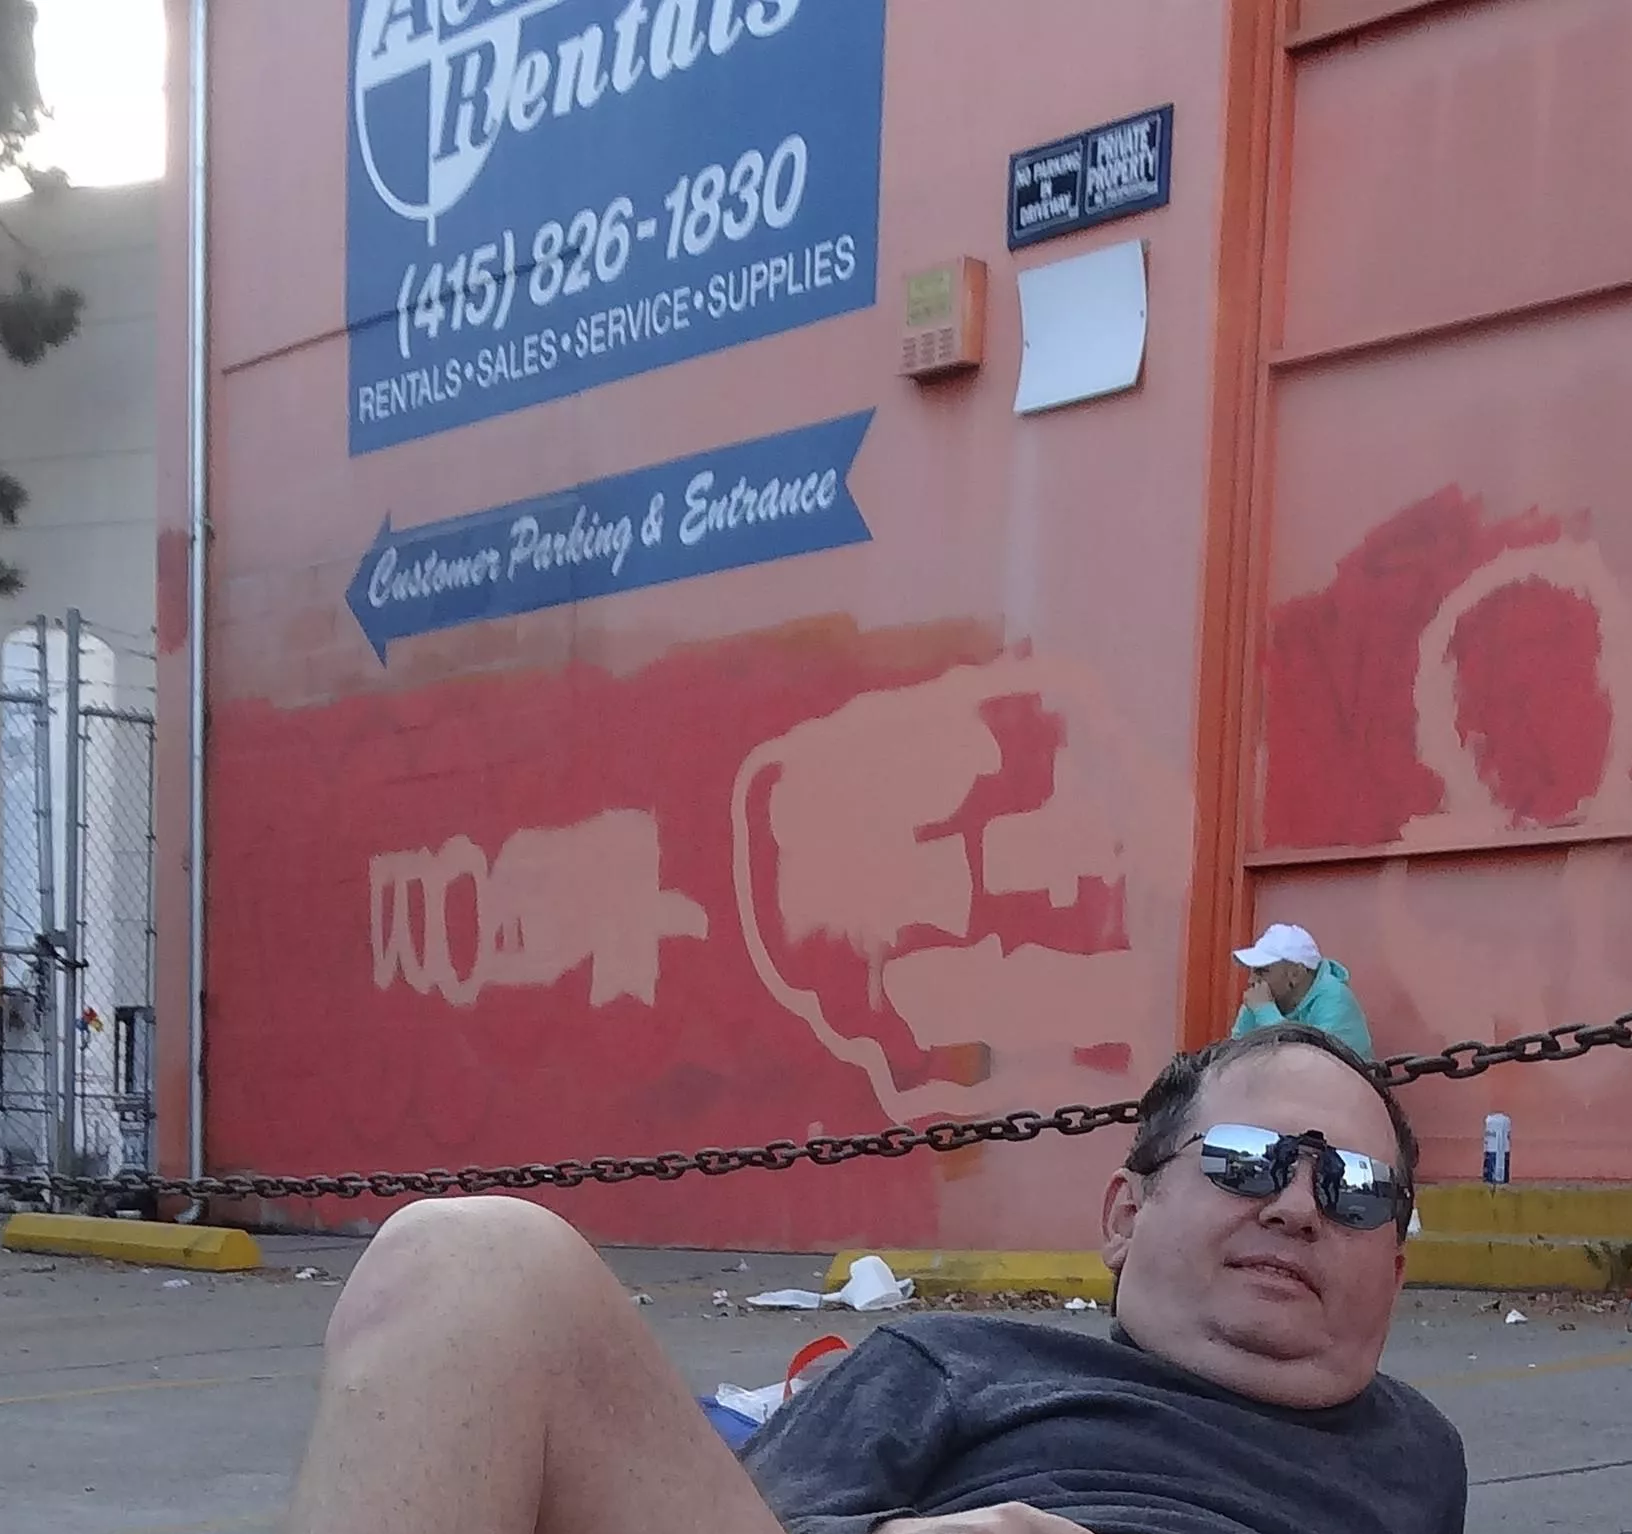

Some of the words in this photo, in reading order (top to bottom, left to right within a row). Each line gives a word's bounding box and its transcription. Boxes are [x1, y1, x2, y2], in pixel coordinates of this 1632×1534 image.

[358, 358, 462, 424] RENTALS
[476, 327, 558, 389] SALES
[575, 286, 691, 359] SERVICE
[707, 234, 856, 319] SUPPLIES
[397, 228, 516, 359] (415)
[529, 133, 807, 307] 826-1830
[368, 546, 500, 608] Customer
[507, 504, 632, 582] Parking
[679, 467, 837, 546] Entrance
